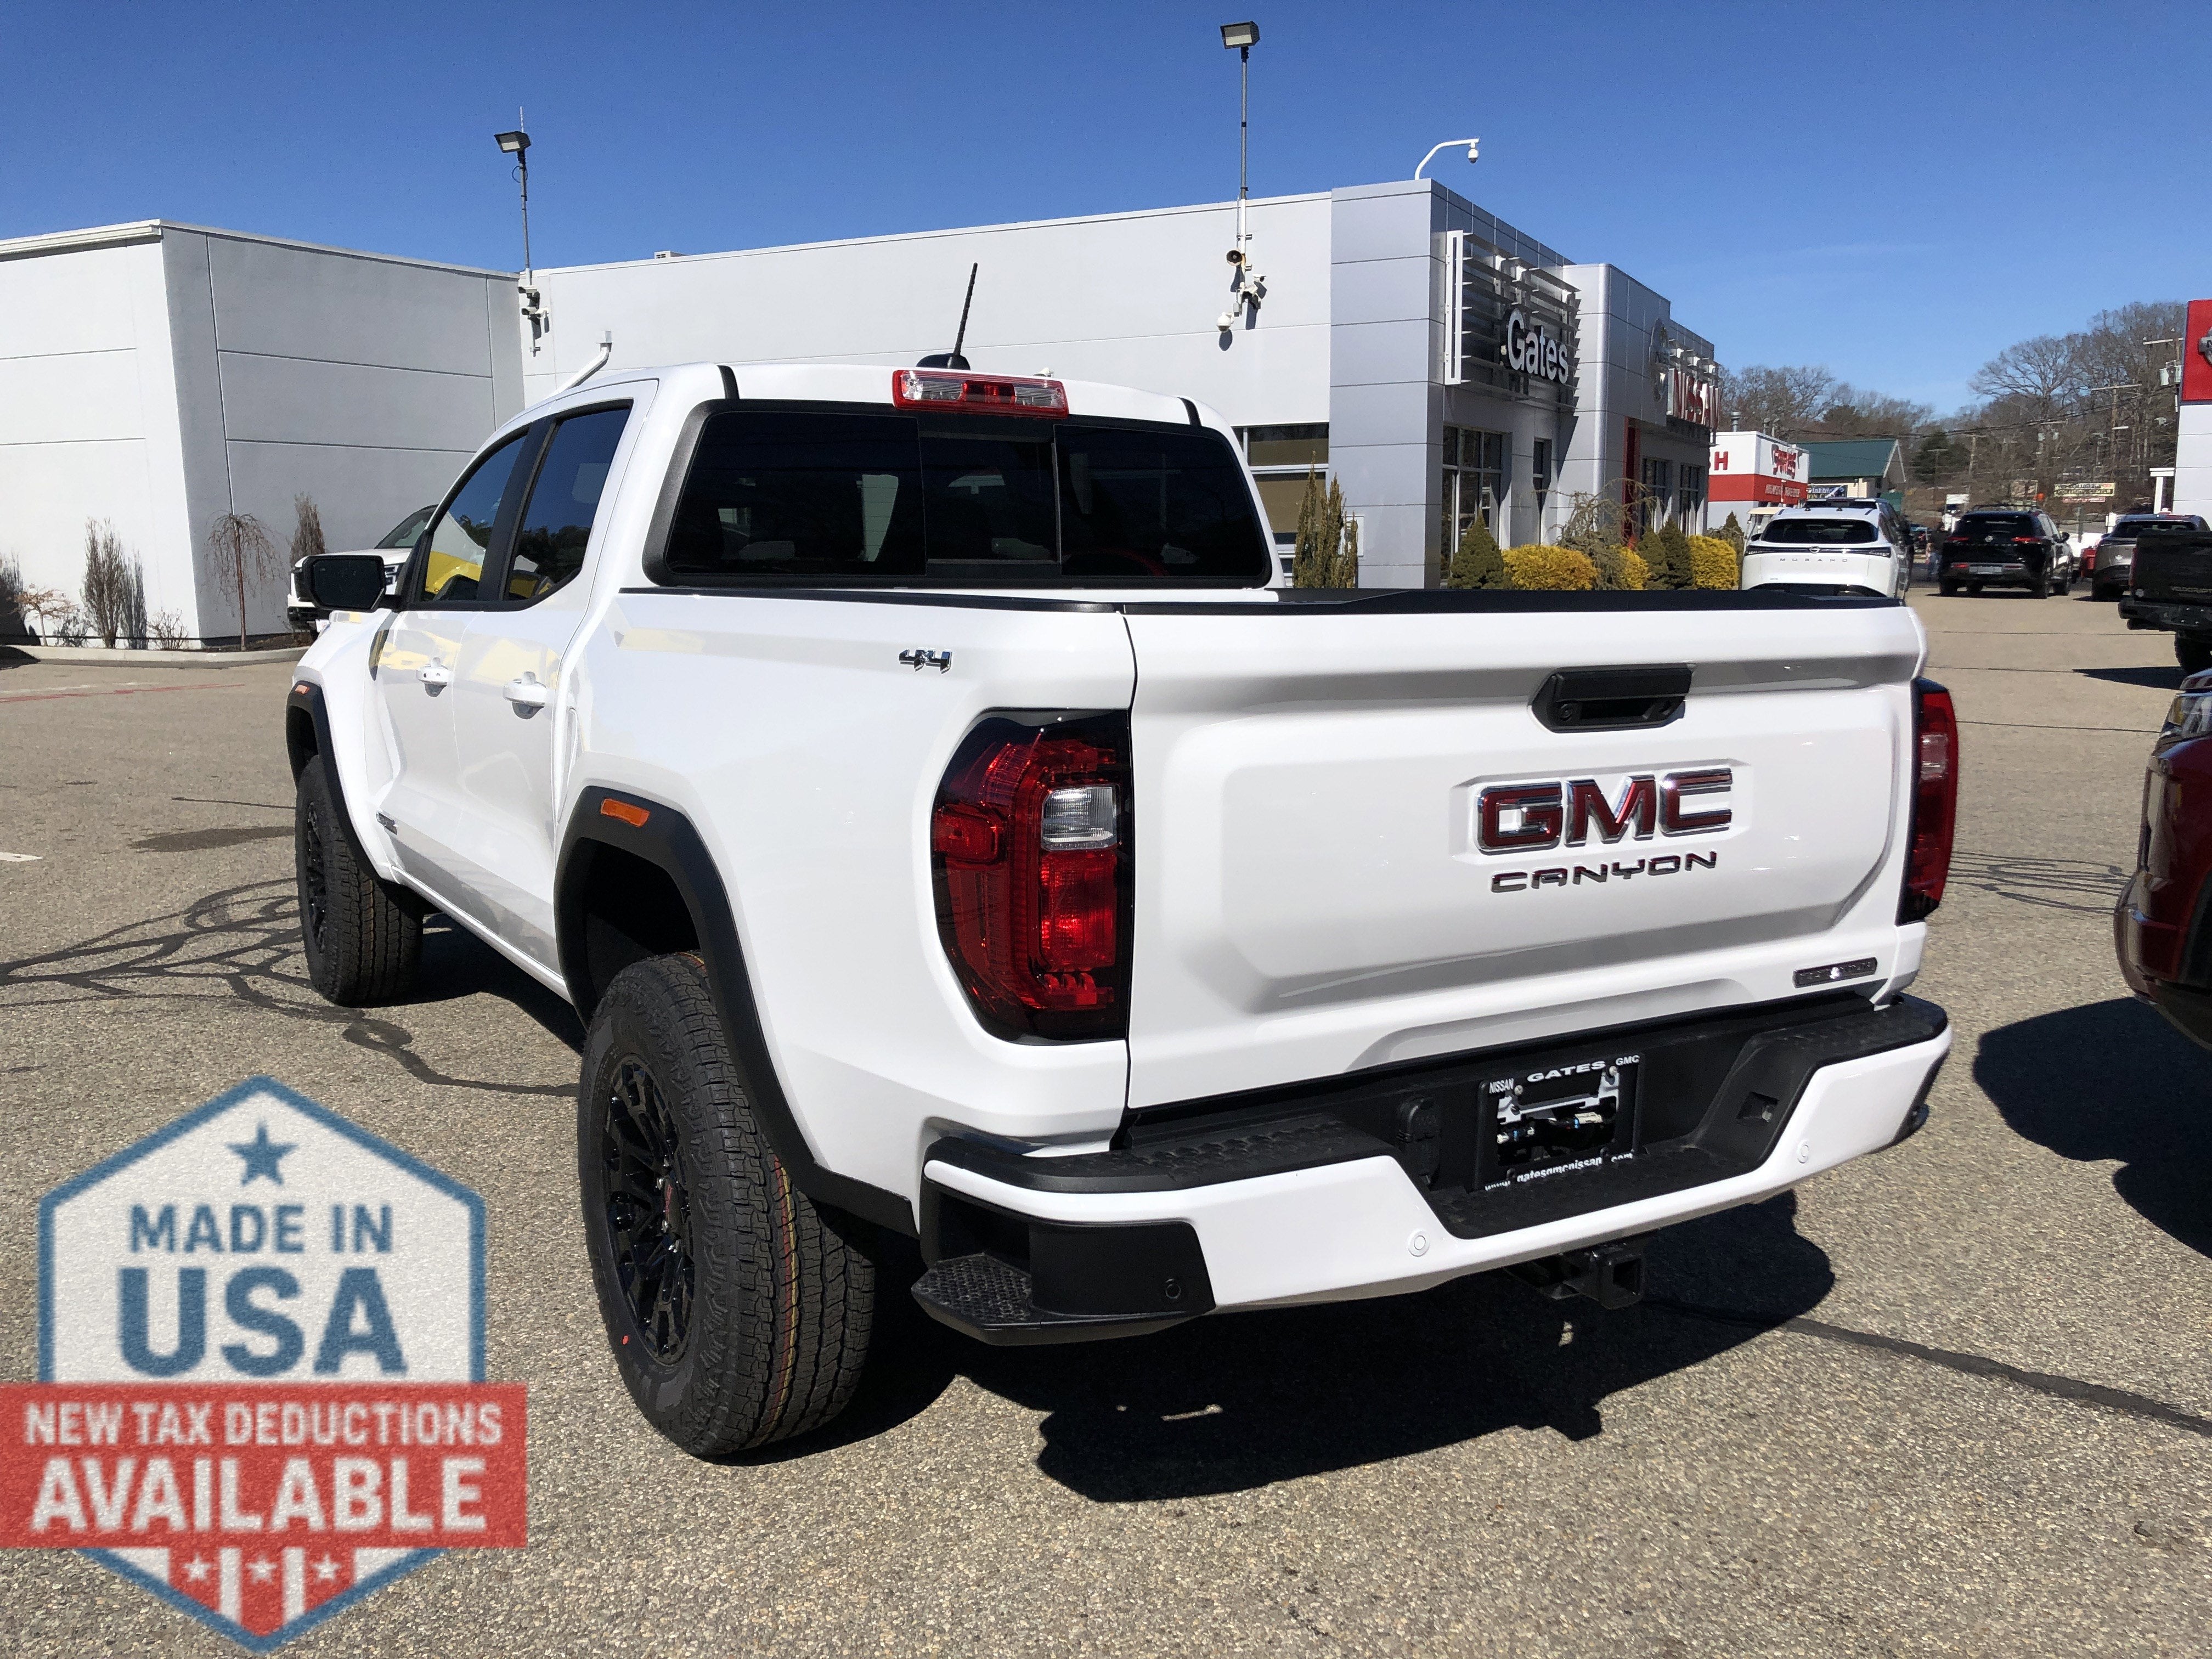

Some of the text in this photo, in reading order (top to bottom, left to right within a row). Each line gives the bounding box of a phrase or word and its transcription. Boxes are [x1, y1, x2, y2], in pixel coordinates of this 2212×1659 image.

[1508, 308, 1568, 384] Gates
[1709, 451, 1729, 471] H
[1477, 768, 1733, 855] GMC
[1490, 850, 1718, 893] CANYON
[1489, 1054, 1640, 1094] NISSAN GATES GMC
